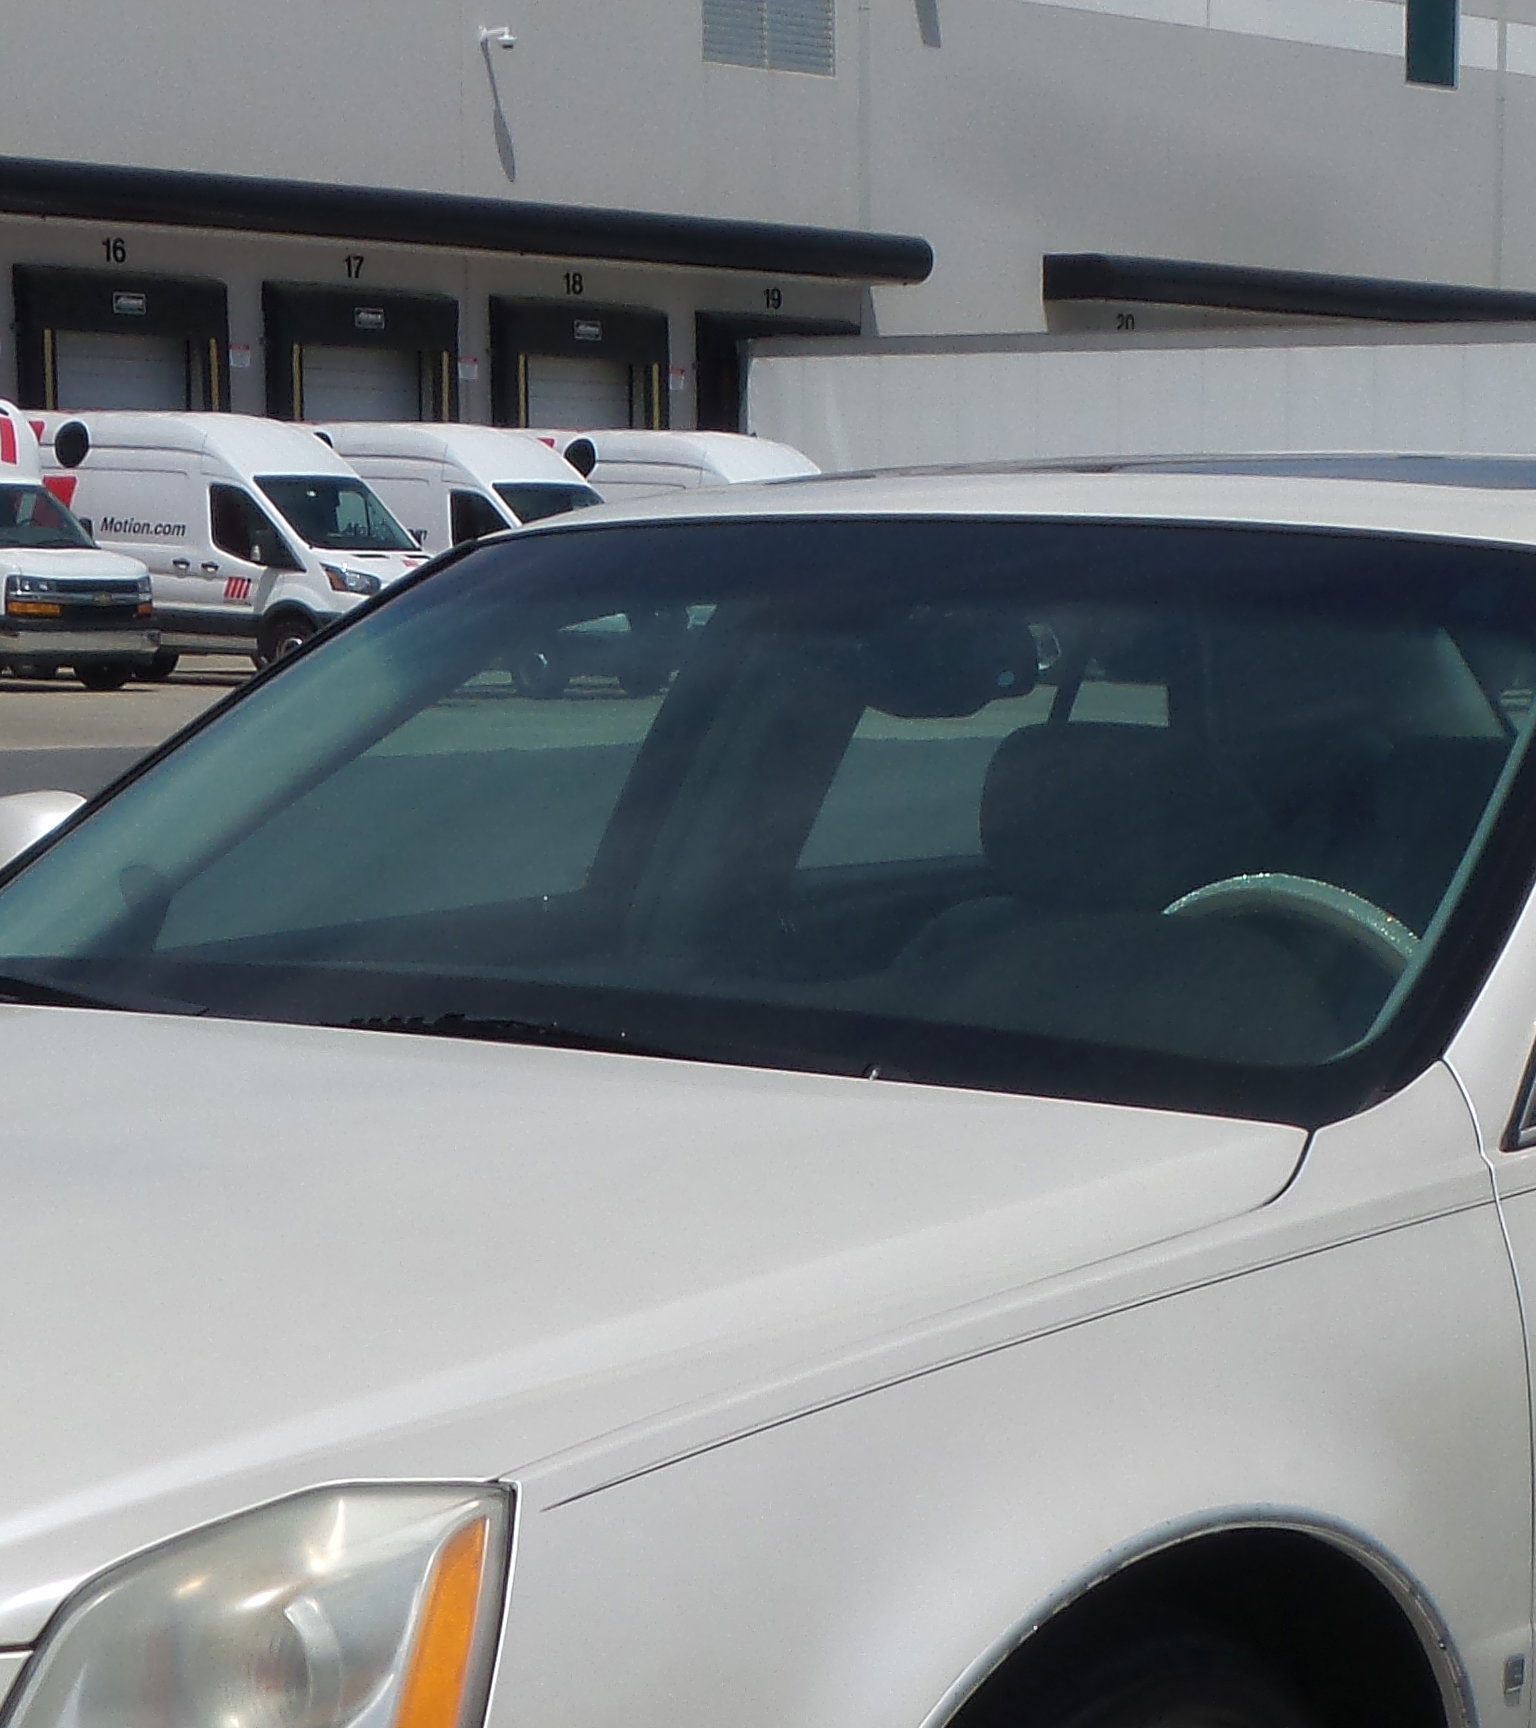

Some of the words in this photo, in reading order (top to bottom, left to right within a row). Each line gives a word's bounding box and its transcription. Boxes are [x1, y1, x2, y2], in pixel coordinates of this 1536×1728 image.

[102, 237, 127, 263] 16
[344, 255, 364, 279] 17
[563, 272, 584, 295] 18
[764, 288, 783, 310] 19
[100, 516, 186, 537] Motion.com
